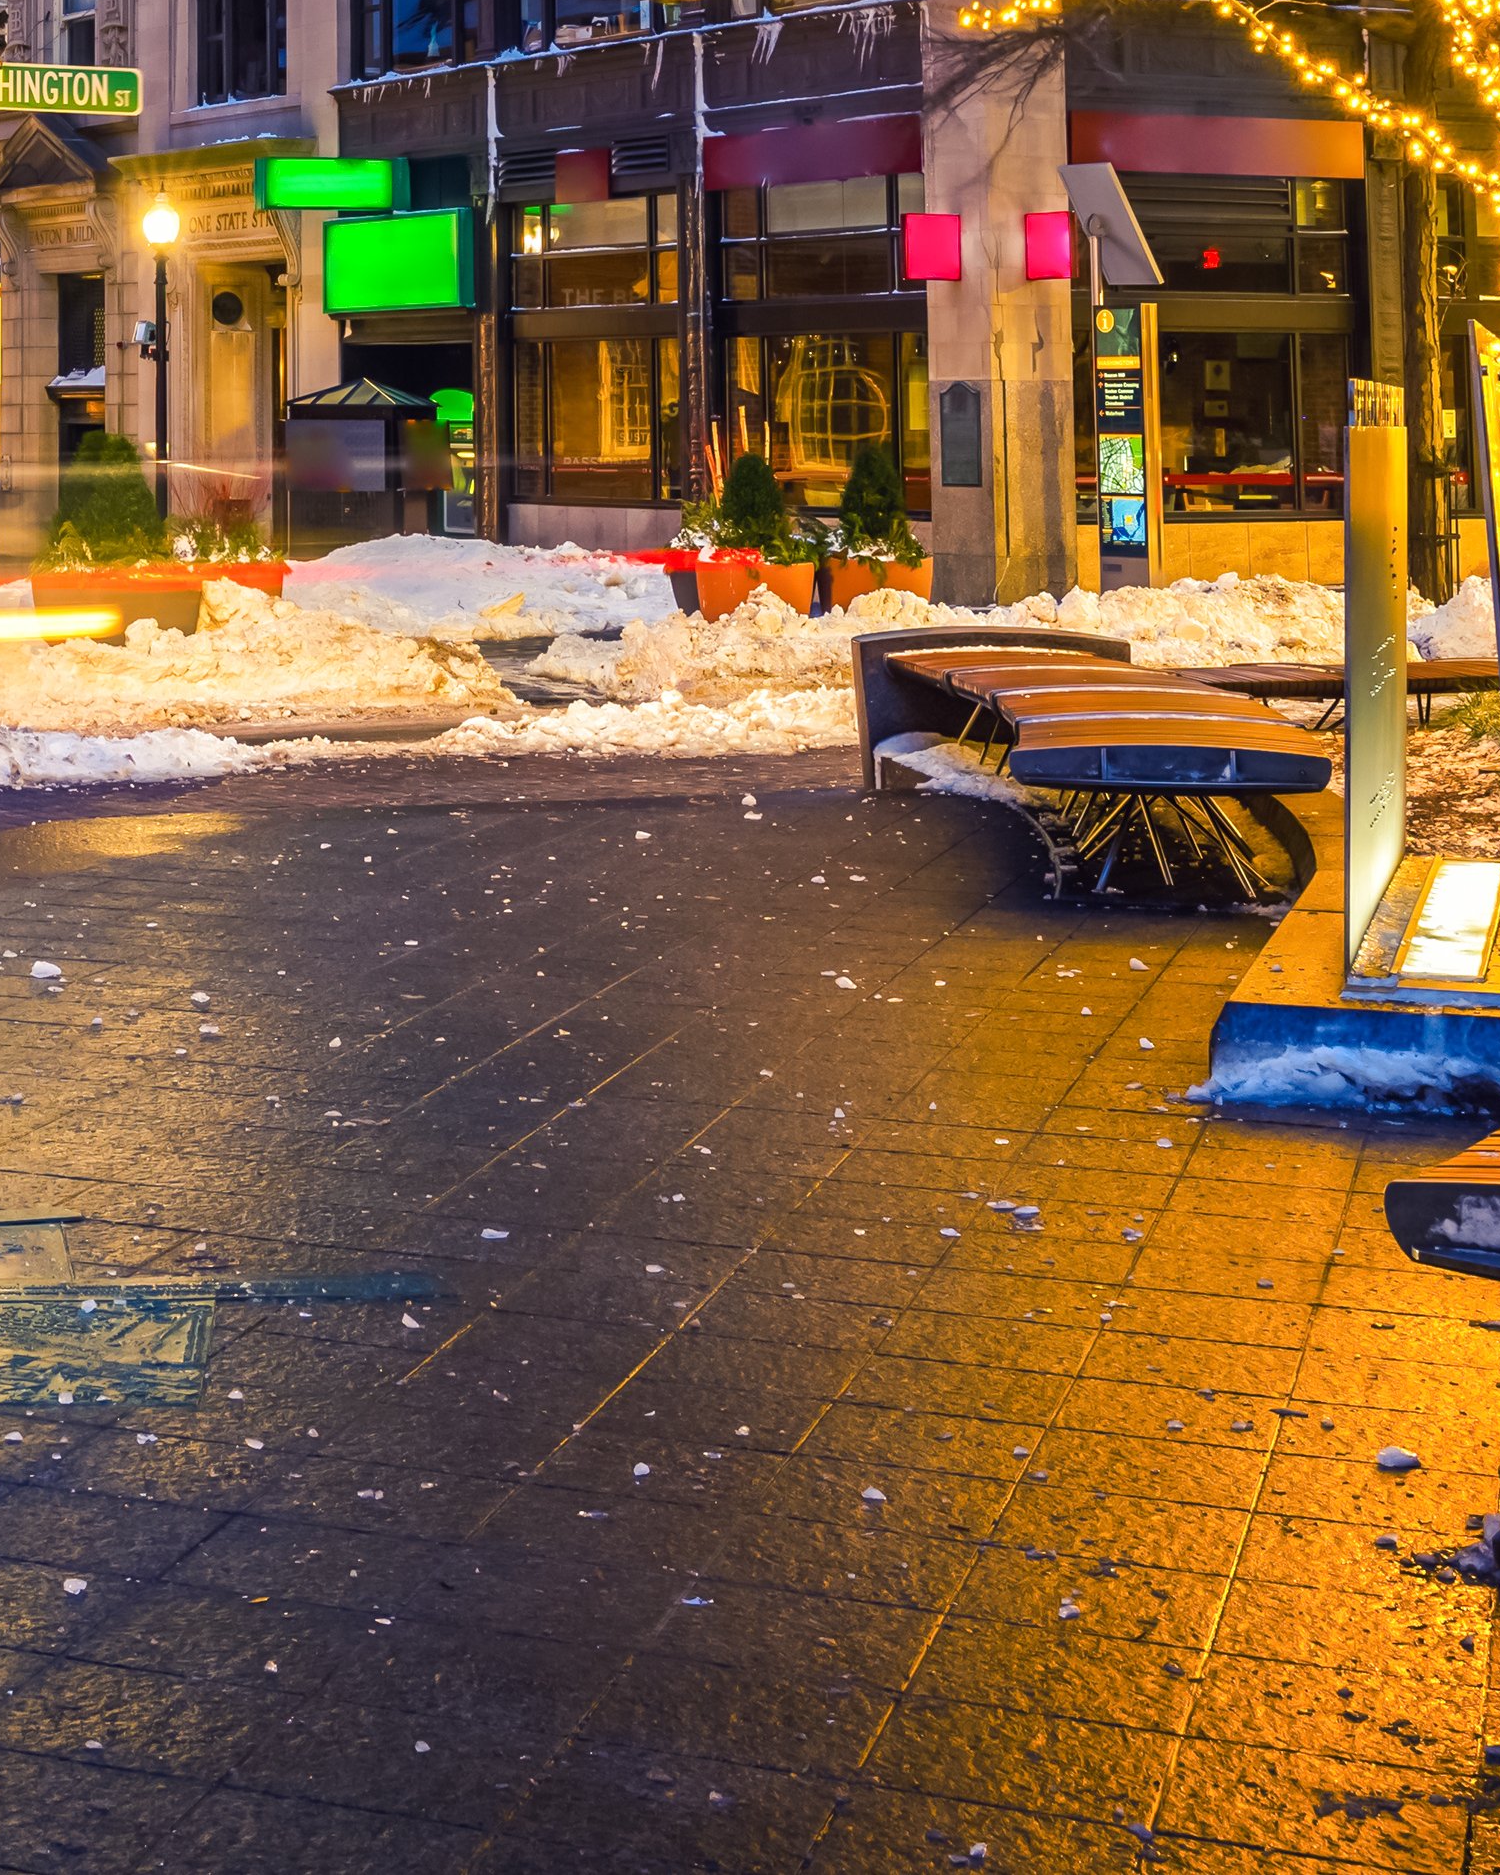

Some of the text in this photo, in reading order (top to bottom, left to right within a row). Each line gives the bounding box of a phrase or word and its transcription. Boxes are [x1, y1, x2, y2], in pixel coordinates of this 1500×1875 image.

[114, 89, 132, 107] ST
[189, 215, 211, 233] ONE
[216, 211, 247, 231] STATE
[66, 226, 98, 243] BUILDI
[561, 288, 604, 305] THE
[619, 431, 650, 442] SUST
[563, 456, 648, 465] PASSION
